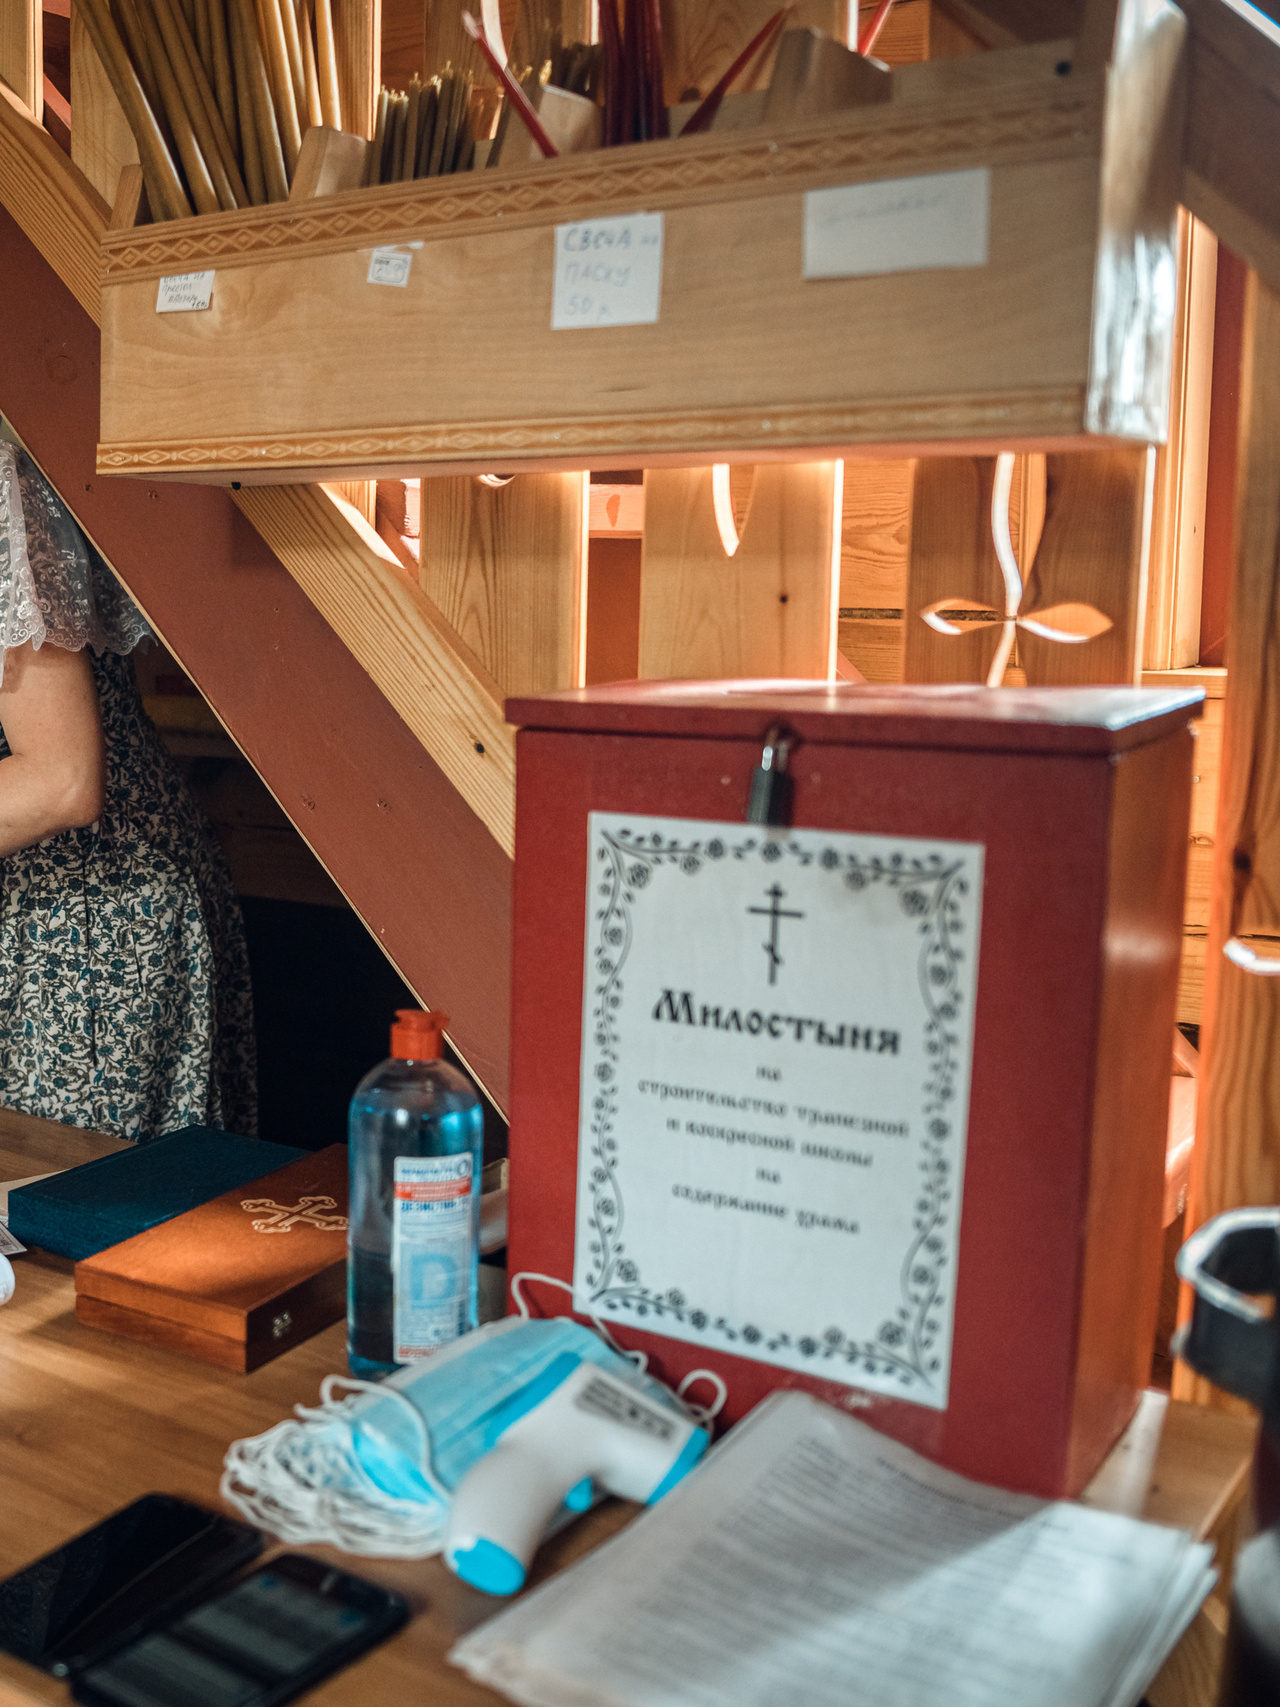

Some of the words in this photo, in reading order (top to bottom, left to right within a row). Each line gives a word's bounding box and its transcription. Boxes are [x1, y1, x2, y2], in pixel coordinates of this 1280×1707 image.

[650, 987, 903, 1056] Милостыня
[754, 1064, 782, 1082] на
[637, 1078, 789, 1119] строительство
[796, 1106, 910, 1137] трапезной
[666, 1117, 680, 1132] и
[801, 1142, 873, 1167] школы
[755, 1166, 783, 1185] на
[671, 1183, 789, 1219] содержание
